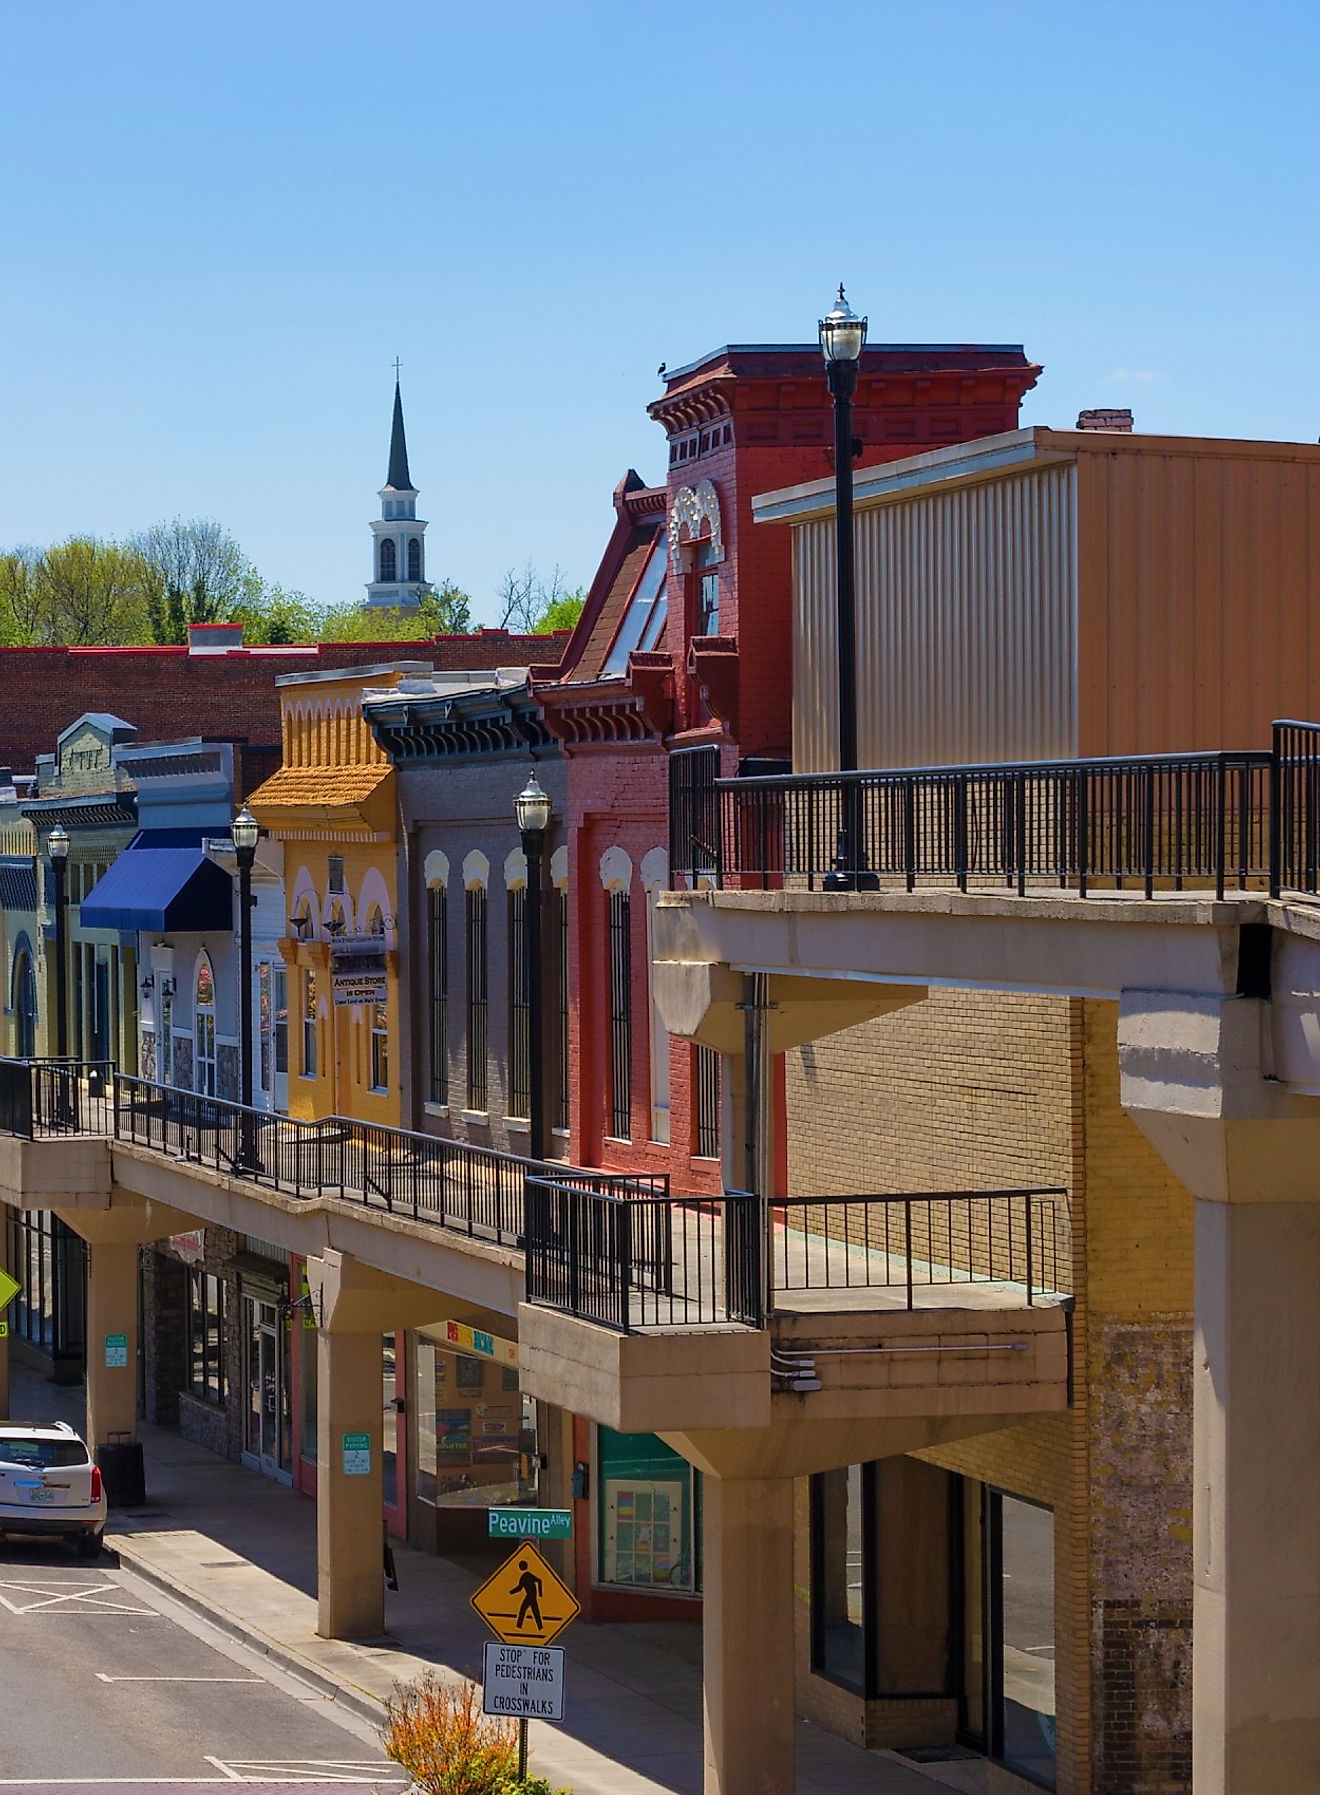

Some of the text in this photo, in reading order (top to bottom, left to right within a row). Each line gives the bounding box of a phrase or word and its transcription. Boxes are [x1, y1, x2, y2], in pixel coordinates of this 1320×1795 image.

[488, 1512, 571, 1534] Peavine Alley
[499, 1648, 551, 1666] STOP FOR
[495, 1664, 554, 1682] PEDESTRIANS
[519, 1682, 529, 1696] IN
[493, 1695, 553, 1715] CROSSWALKS
